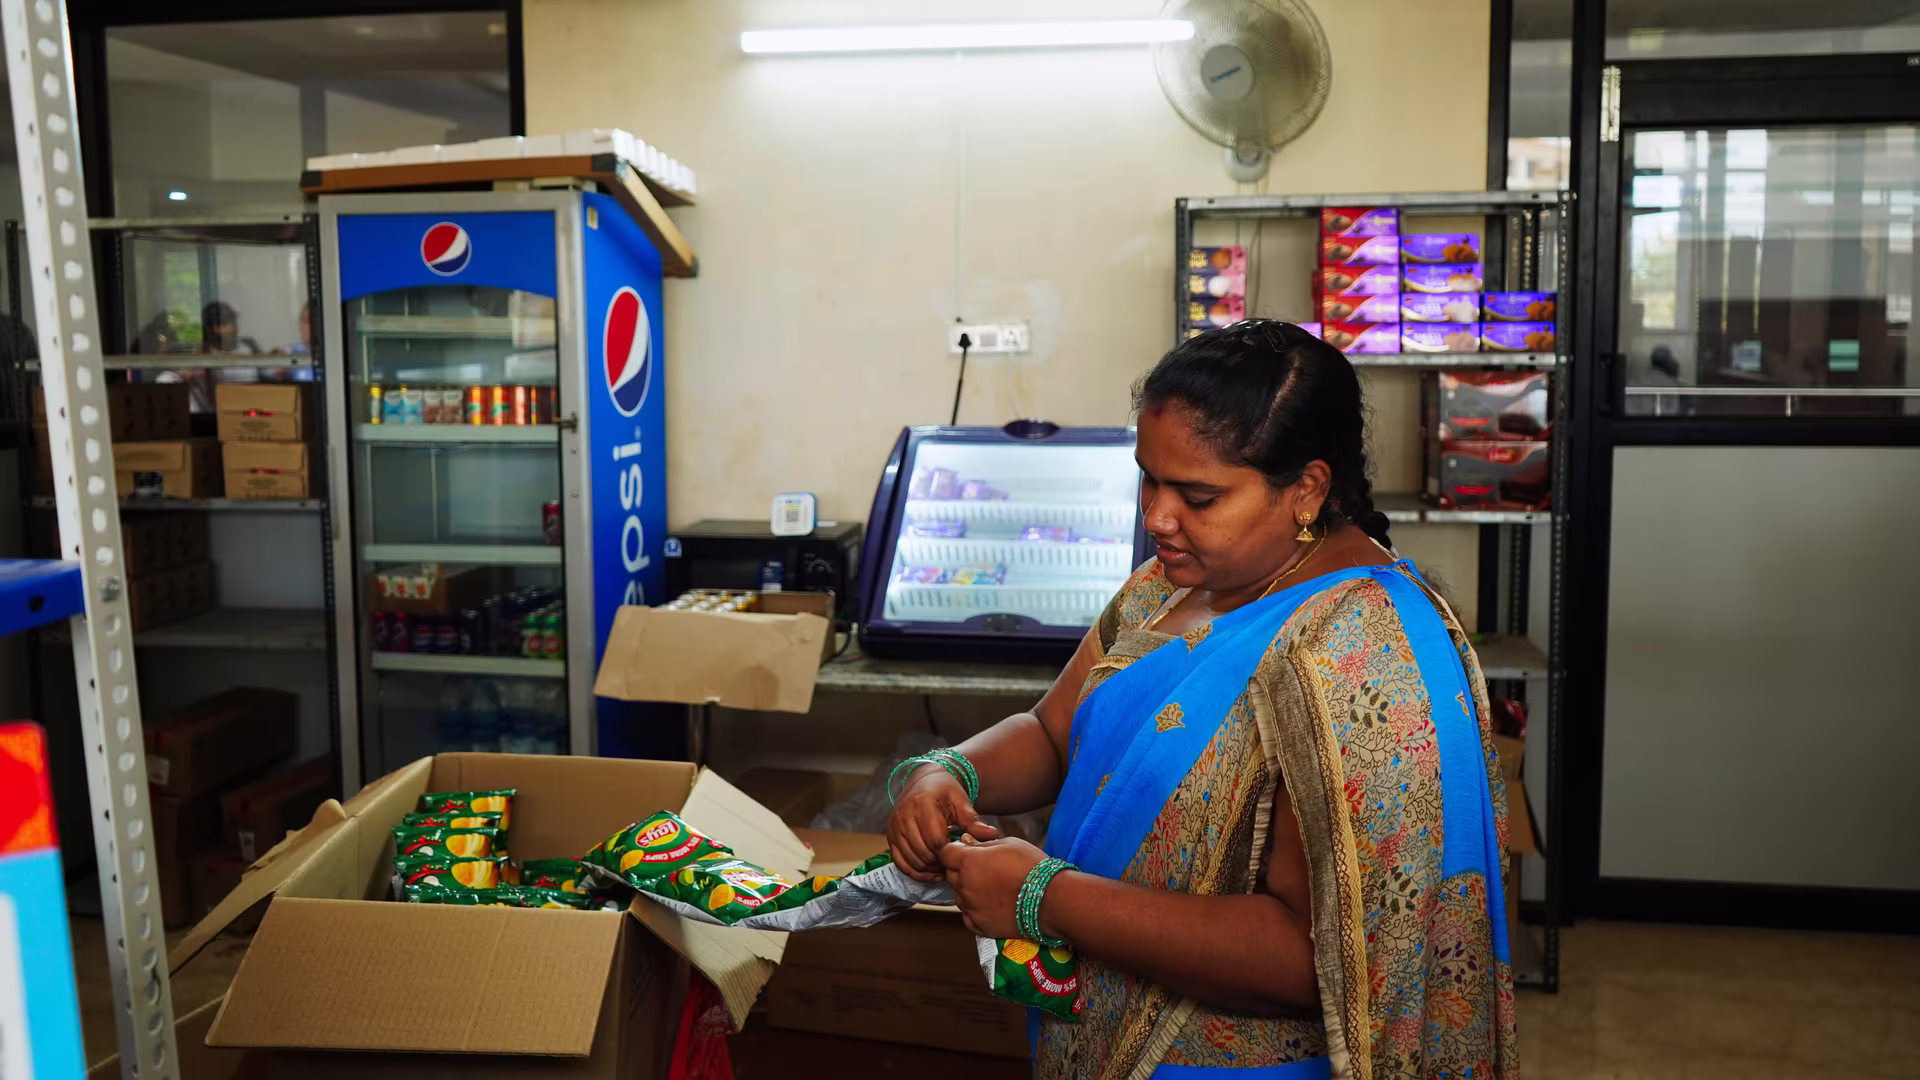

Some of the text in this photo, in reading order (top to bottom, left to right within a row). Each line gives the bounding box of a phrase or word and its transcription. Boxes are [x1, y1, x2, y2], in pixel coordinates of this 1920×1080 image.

[612, 442, 650, 605] epsi
[1041, 978, 1063, 993] MORE
[1063, 977, 1077, 992] 25%
